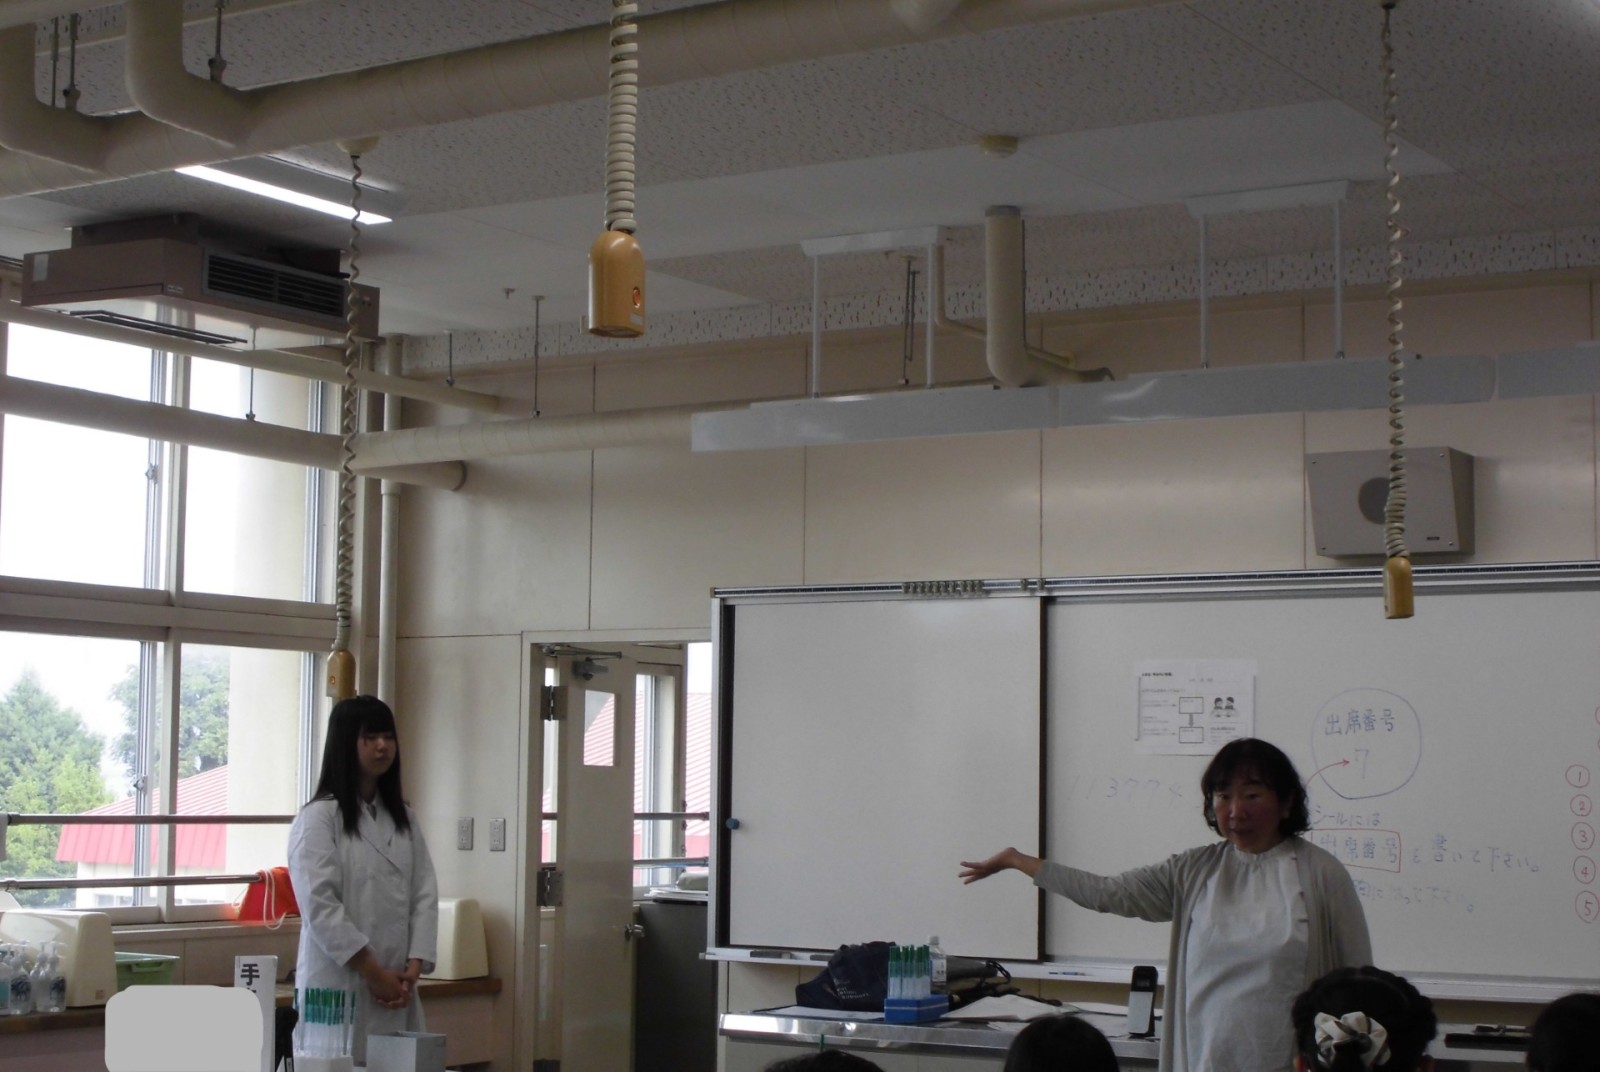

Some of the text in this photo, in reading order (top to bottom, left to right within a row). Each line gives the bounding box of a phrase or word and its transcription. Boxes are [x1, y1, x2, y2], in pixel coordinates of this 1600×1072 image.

[1324, 708, 1396, 736] 出席番号
[240, 963, 260, 993] 手
